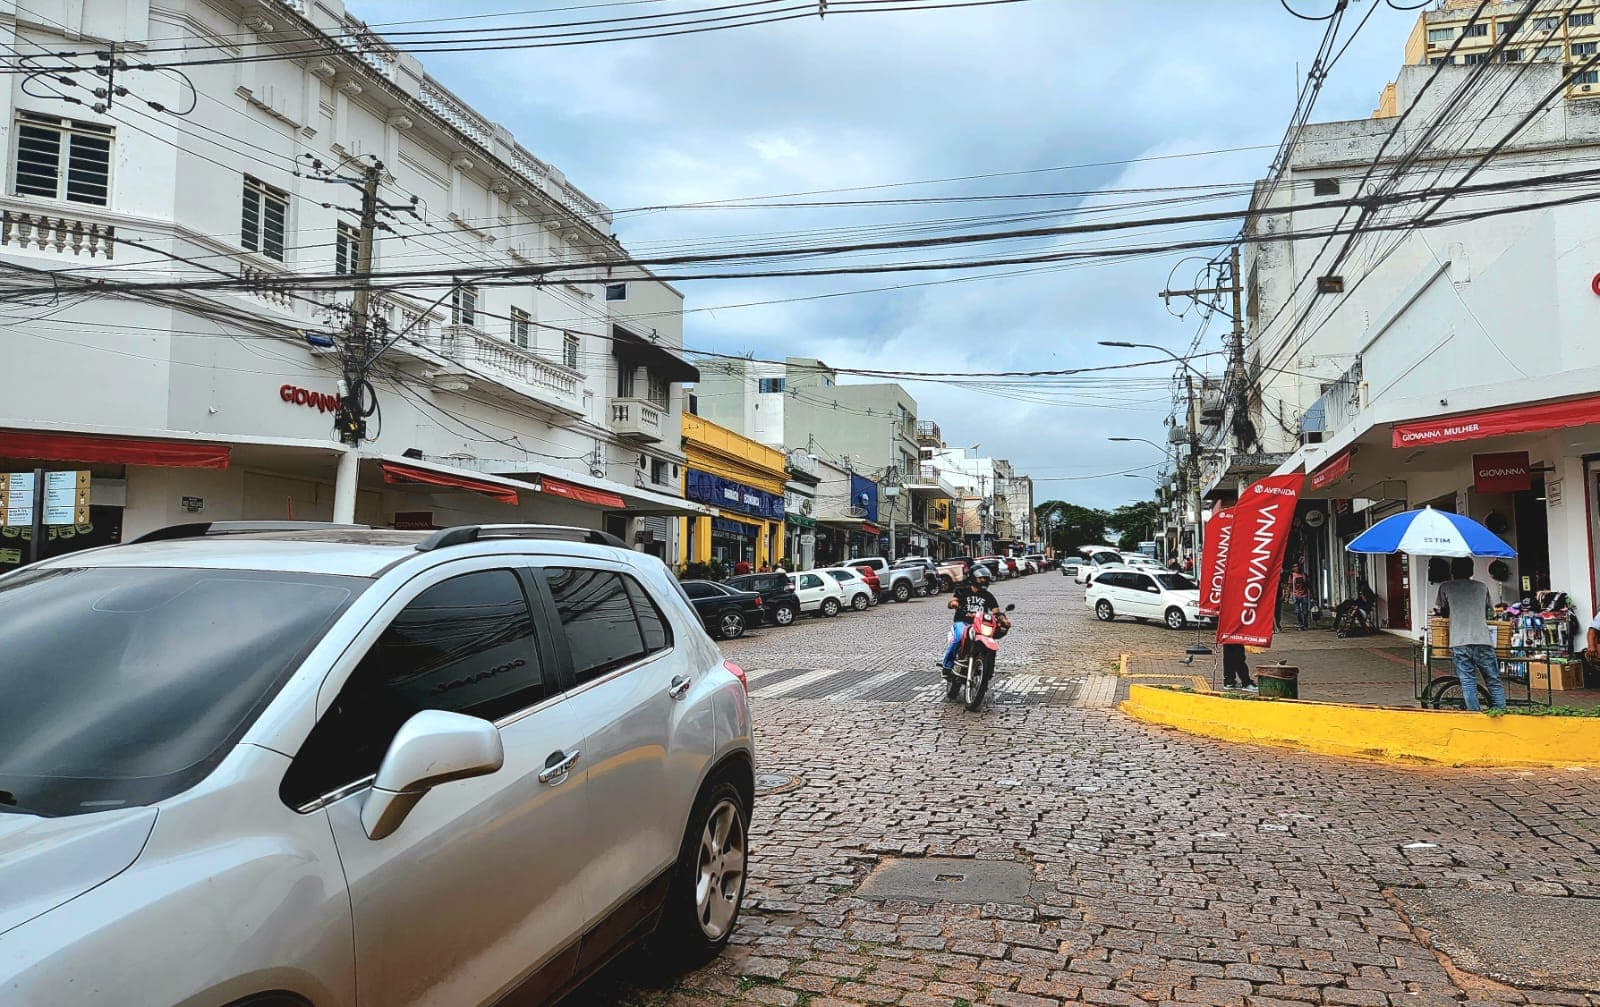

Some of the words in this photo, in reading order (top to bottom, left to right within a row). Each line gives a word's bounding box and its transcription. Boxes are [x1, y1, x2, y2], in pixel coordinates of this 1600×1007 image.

[280, 384, 342, 413] GIOVANN
[1402, 430, 1441, 442] GIOVANNA
[1443, 423, 1479, 436] MULHER
[1479, 467, 1525, 477] GIOVANNA
[1263, 487, 1296, 497] AVENIDA
[1209, 525, 1232, 605] GIOVANNA
[1240, 503, 1279, 625] GIOVANNA
[966, 595, 986, 605] FIVE
